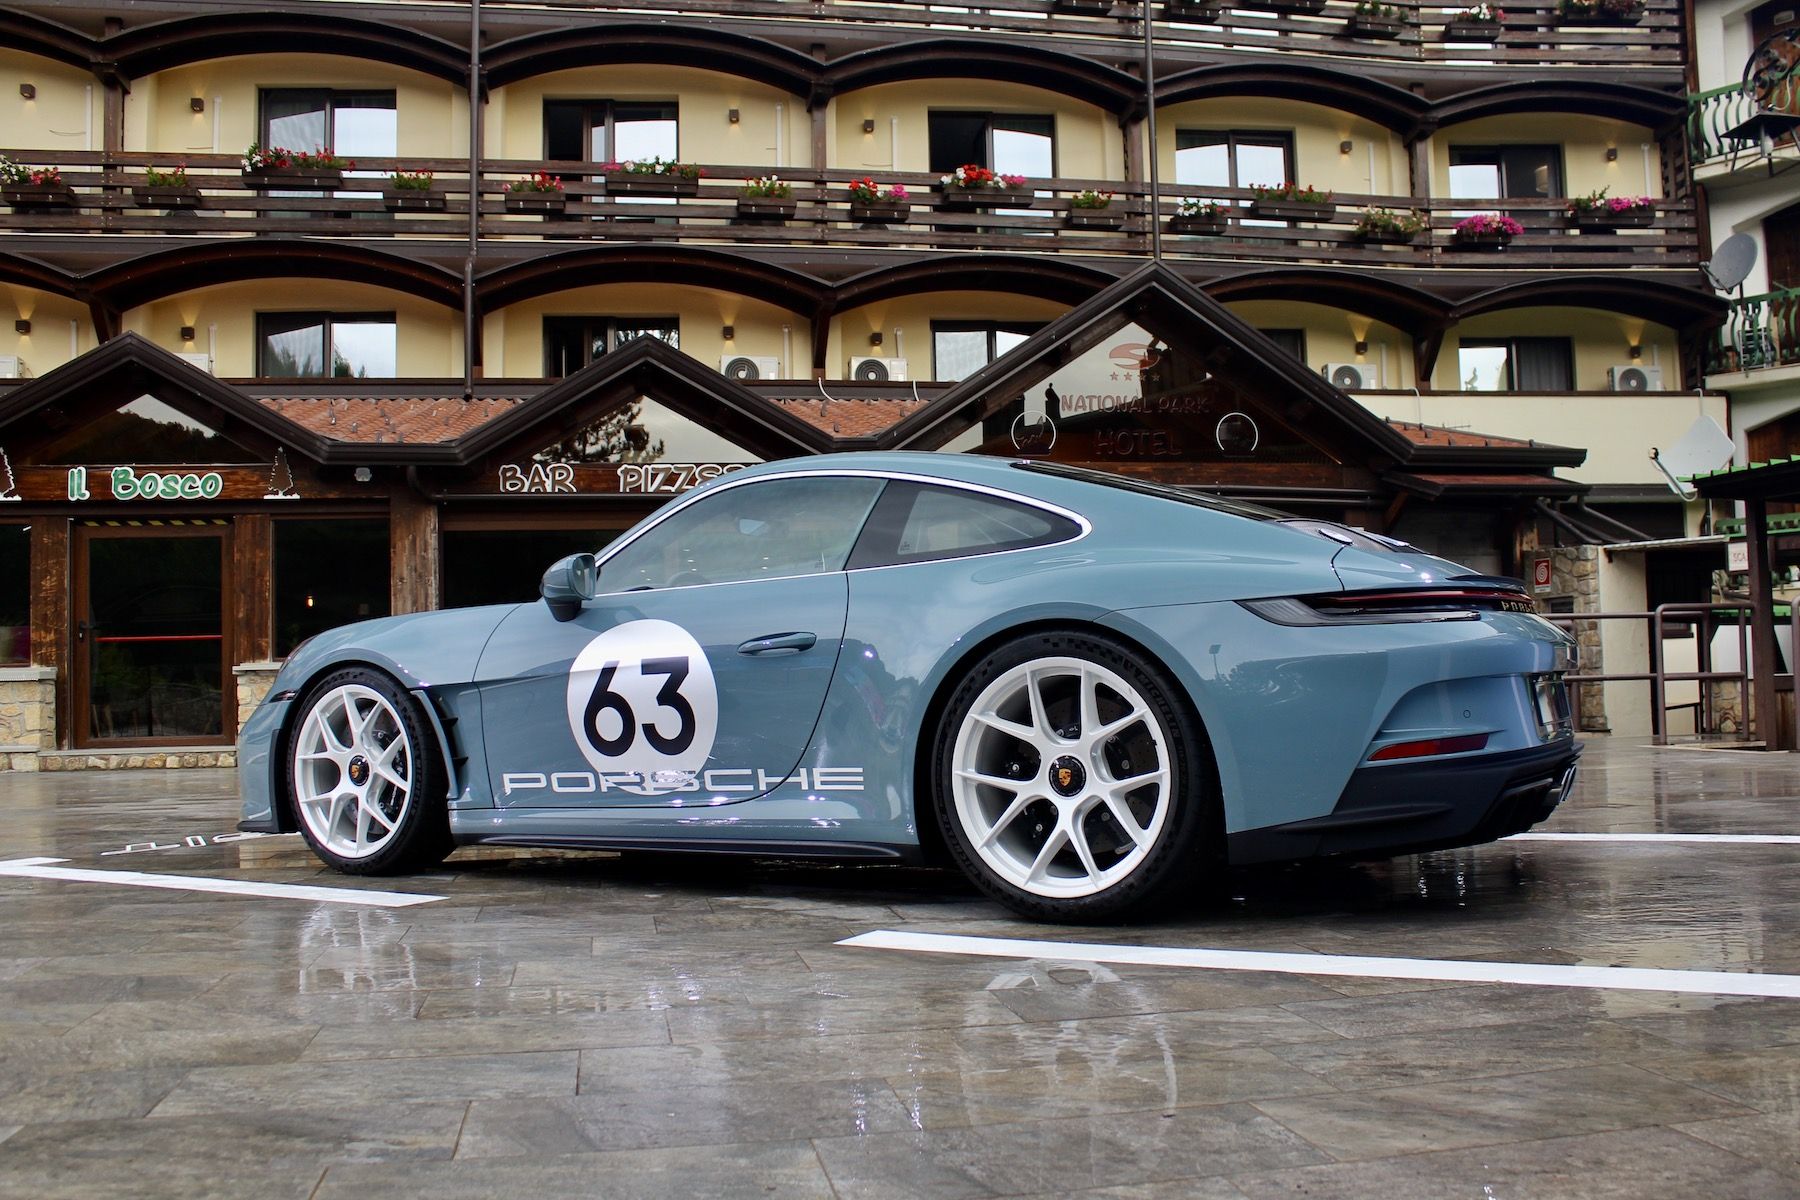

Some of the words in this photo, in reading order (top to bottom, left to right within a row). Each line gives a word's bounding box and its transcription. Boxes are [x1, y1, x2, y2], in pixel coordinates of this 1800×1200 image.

[1060, 394, 1152, 413] NATIONAL
[1158, 396, 1210, 414] PARK
[1096, 429, 1183, 456] HOTEL
[68, 466, 90, 500] Il
[111, 466, 223, 500] Bosco
[500, 463, 577, 492] BAR
[617, 463, 756, 492] PIZZE
[583, 655, 696, 757] 63
[502, 767, 865, 793] PORSCHE
